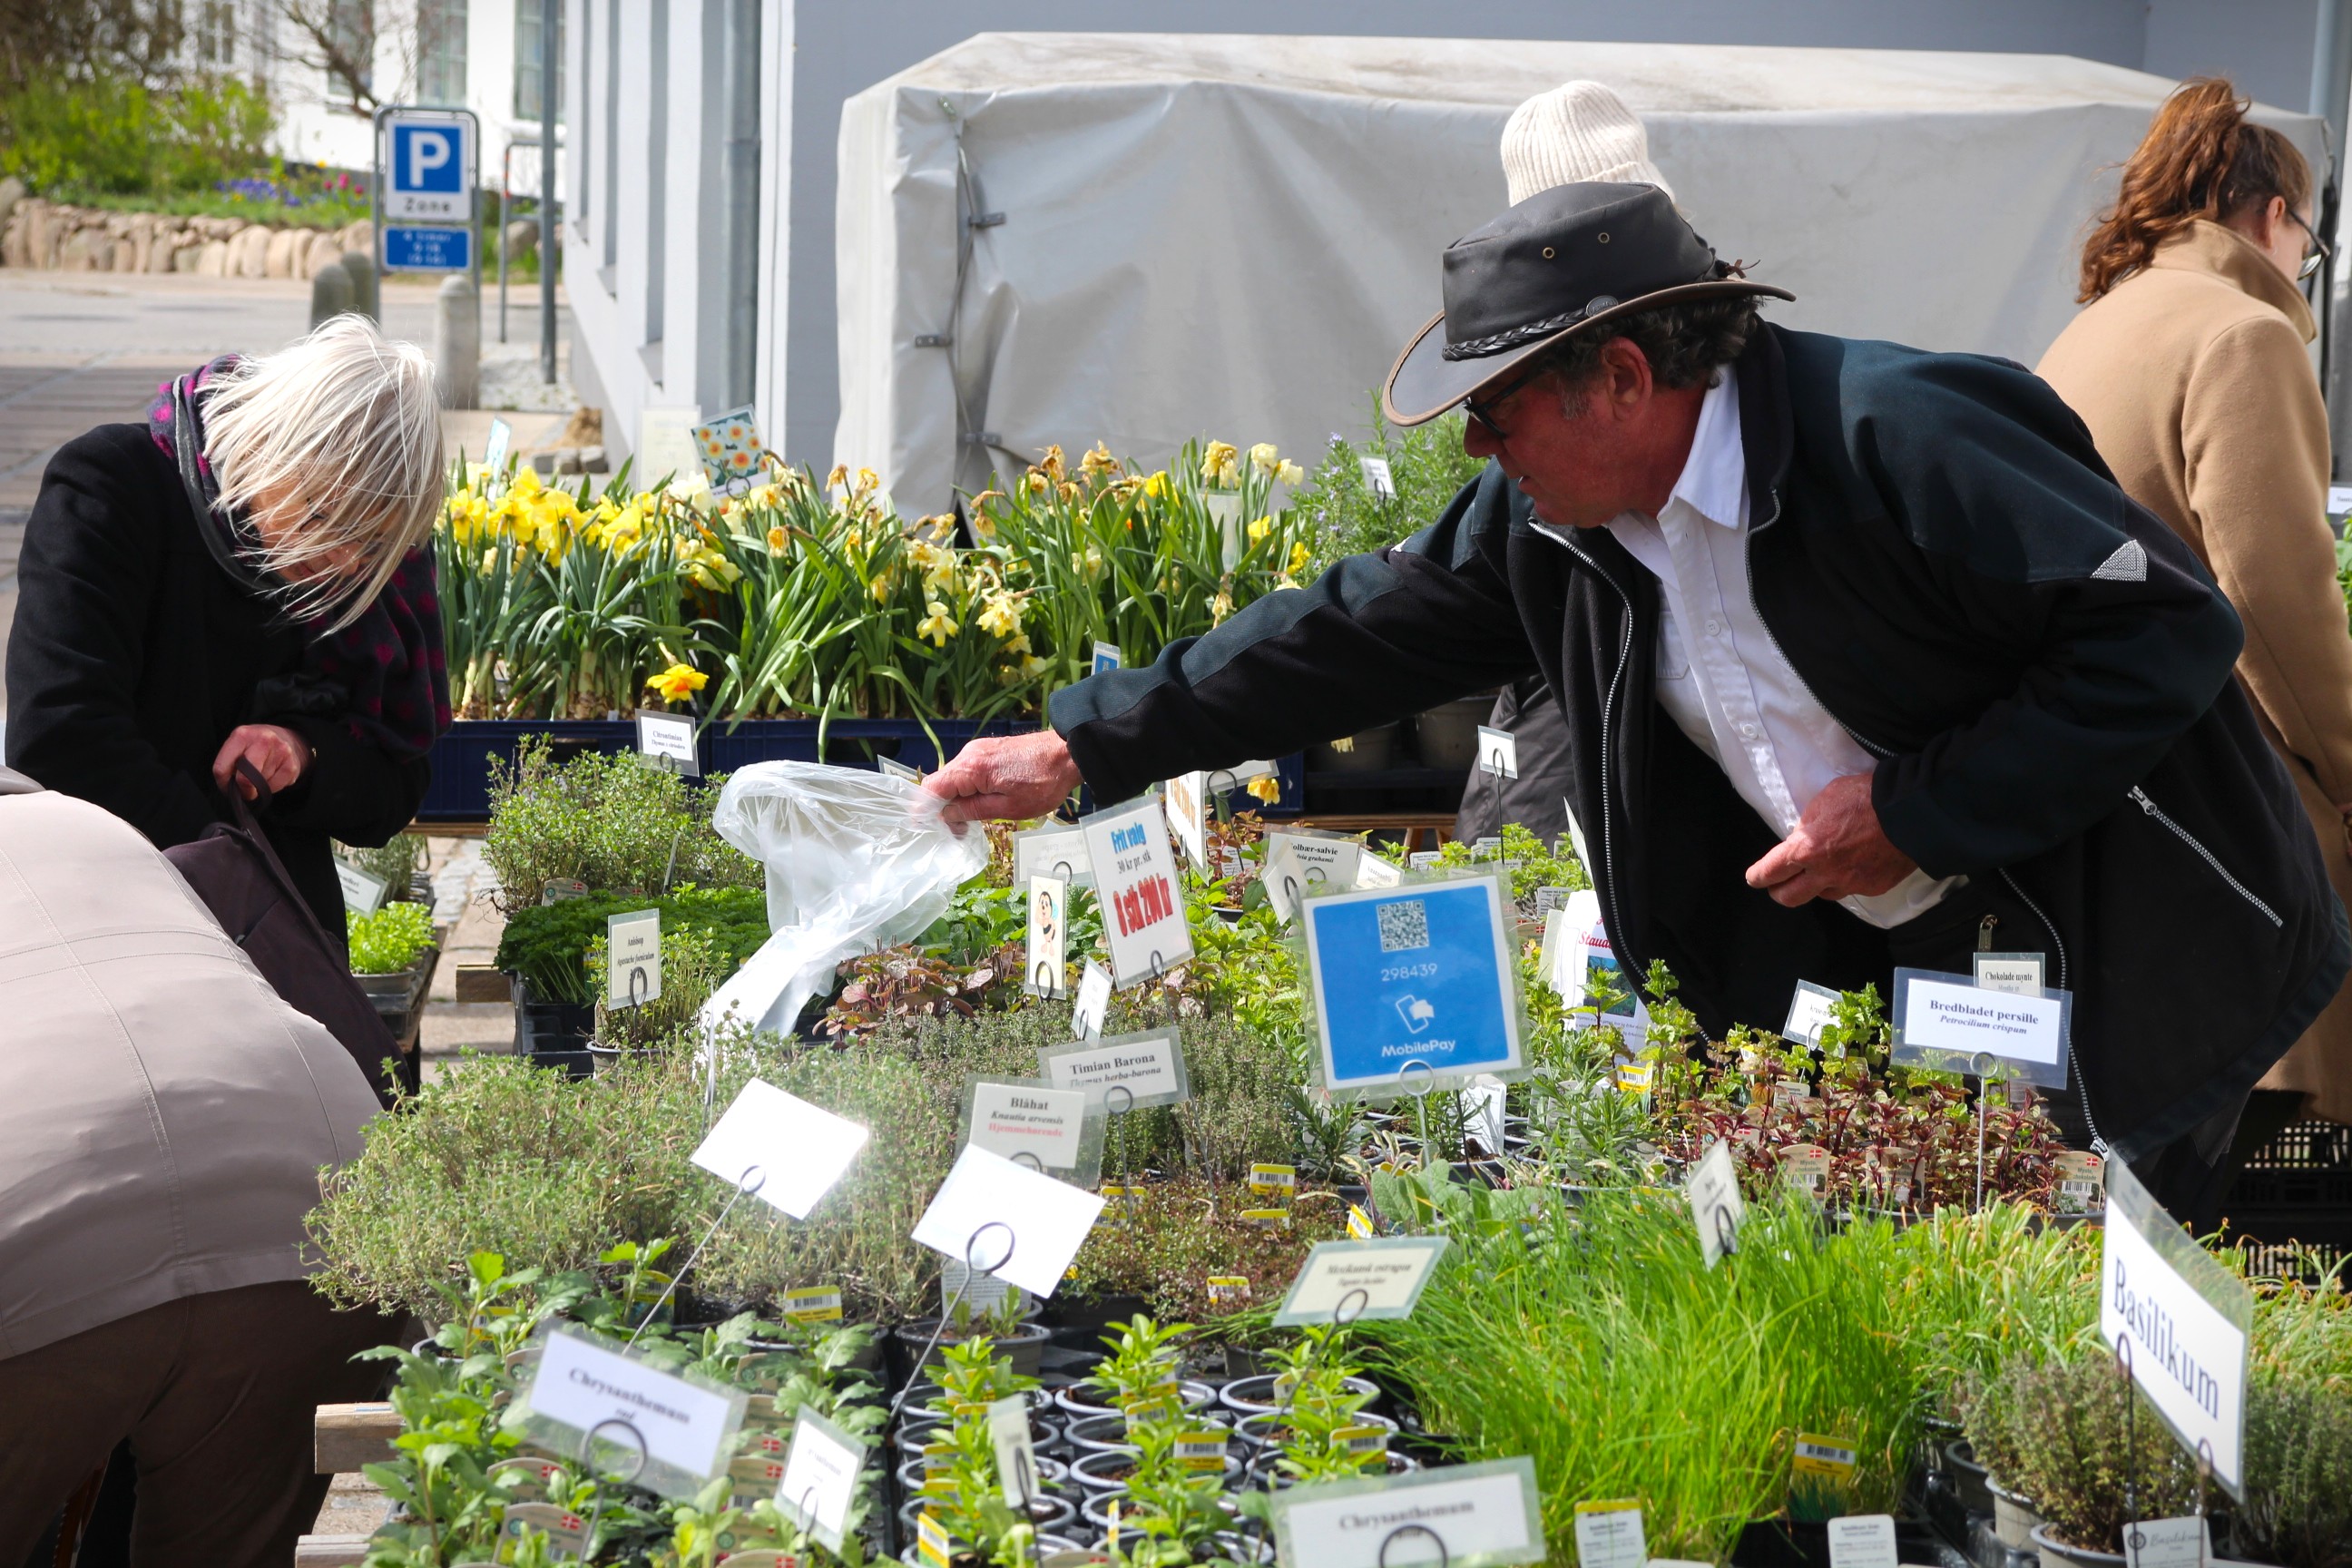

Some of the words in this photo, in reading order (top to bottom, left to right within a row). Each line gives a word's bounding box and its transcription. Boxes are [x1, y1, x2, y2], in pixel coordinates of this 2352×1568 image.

[409, 131, 451, 188] P
[403, 197, 452, 213] Zone
[652, 730, 682, 741] Citrontimian
[1111, 829, 1128, 854] Frit
[1126, 822, 1147, 847] valg
[1290, 843, 1338, 856] olbær-salvie
[1117, 861, 1125, 874] 30
[1125, 858, 1133, 872] kr
[1133, 857, 1143, 871] pr.
[1143, 849, 1152, 863] stk
[1138, 875, 1163, 926] 200
[1156, 872, 1173, 916] kr
[1380, 963, 1438, 982] 298439
[1985, 971, 2015, 981] Chokolade
[2015, 973, 2033, 984] mynte
[1930, 999, 1994, 1017] Bredbladet
[1996, 1009, 2039, 1024] persille
[1940, 1014, 1990, 1029] Petrocilium
[1993, 1024, 2027, 1034] crispum
[1381, 1040, 1456, 1058] MobilePay
[1070, 1060, 1111, 1075] Timian
[1114, 1054, 1155, 1068] Barona
[1104, 1066, 1161, 1082] herba-barona
[1011, 1097, 1049, 1111] Blåhat
[991, 1111, 1025, 1122] Knautia
[1028, 1115, 1063, 1124] arvensis
[2114, 1255, 2219, 1422] Basilikum
[569, 1367, 691, 1424] Chrysanthemum
[1338, 1500, 1475, 1532] Chrysanthemum
